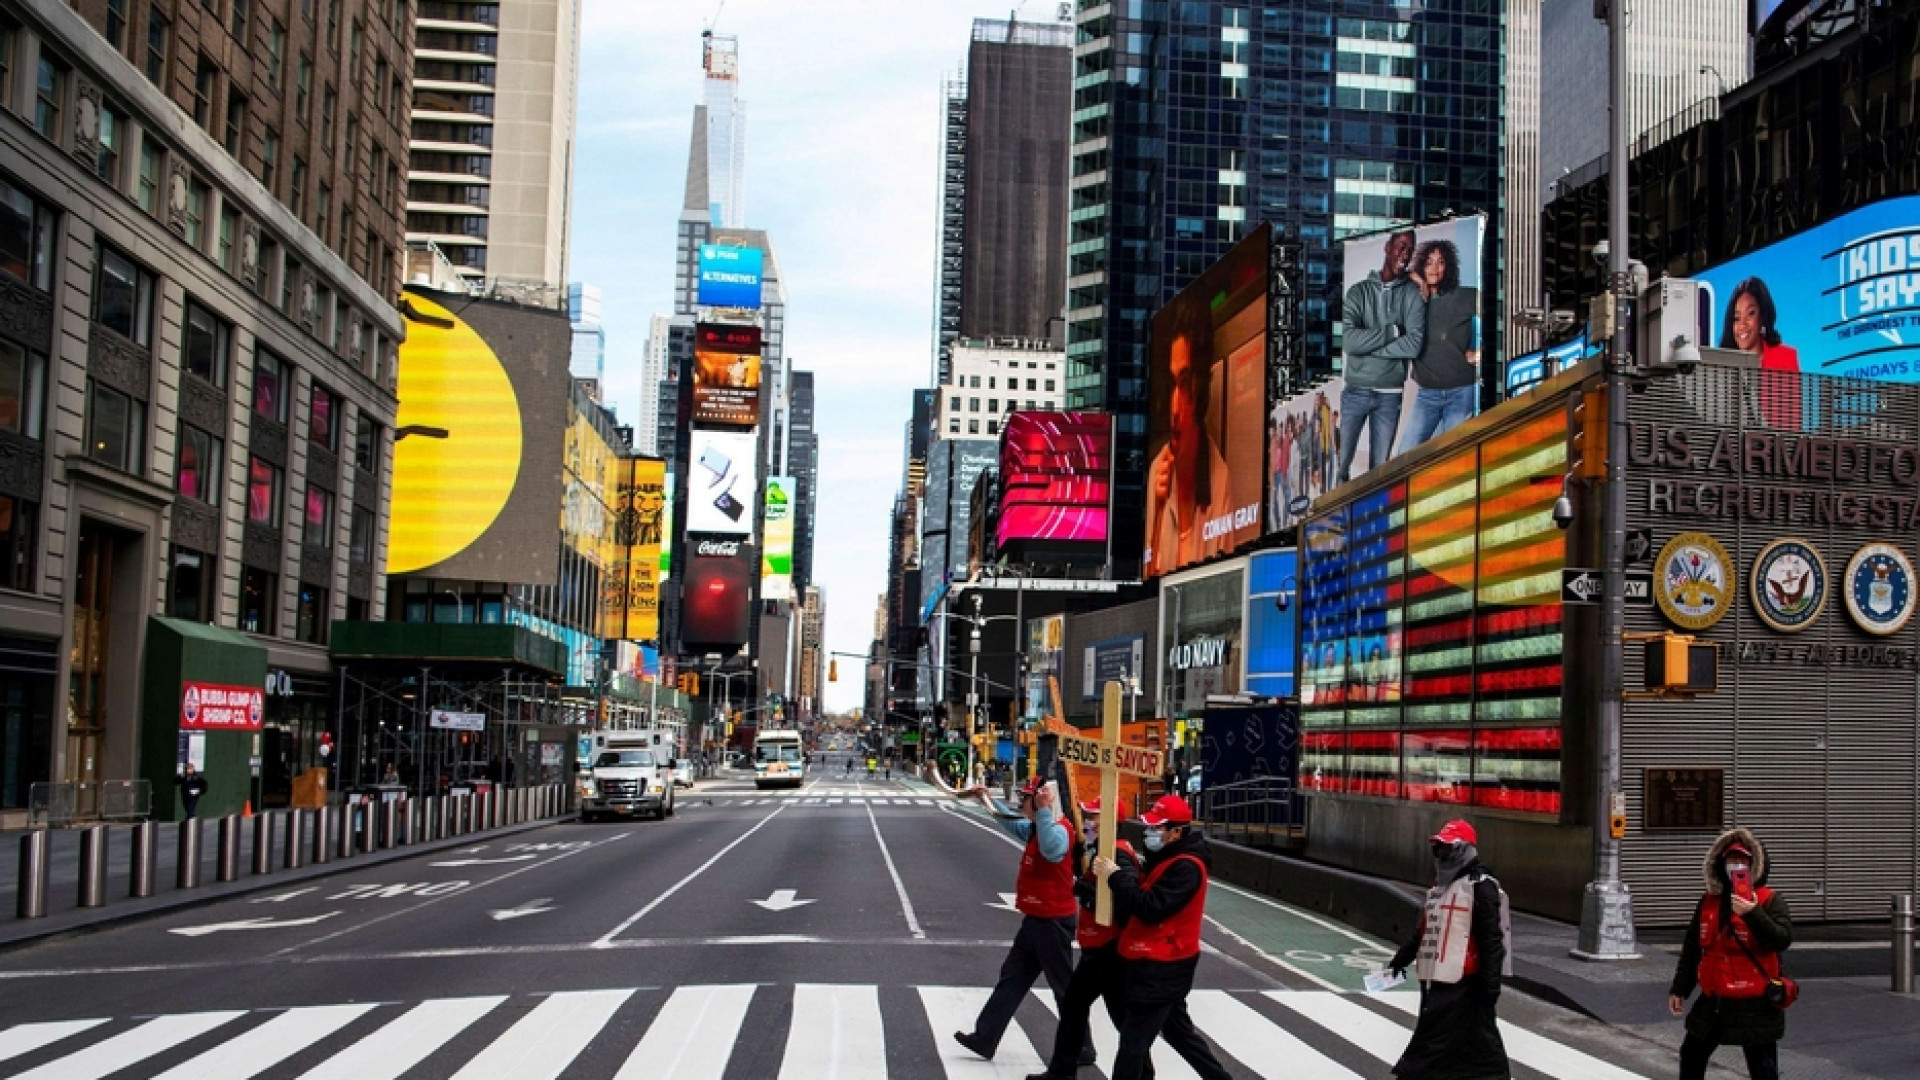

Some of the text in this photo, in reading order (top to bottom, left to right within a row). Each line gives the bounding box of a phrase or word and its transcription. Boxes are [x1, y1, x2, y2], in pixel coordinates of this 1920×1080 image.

[1859, 275, 1920, 314] SAY
[1630, 423, 1701, 468] U.S.
[1709, 431, 1860, 480] ARMED
[1203, 511, 1234, 542] CONAN
[1235, 502, 1260, 531] GRAY
[635, 569, 651, 579] THE
[1576, 579, 1642, 595] ONE AY
[1192, 638, 1225, 668] NAVY
[200, 688, 250, 707] BUBBA GUMP
[202, 707, 232, 723] SHRIMP
[1059, 738, 1099, 764] JESUS
[1115, 746, 1158, 776] SAVIOR
